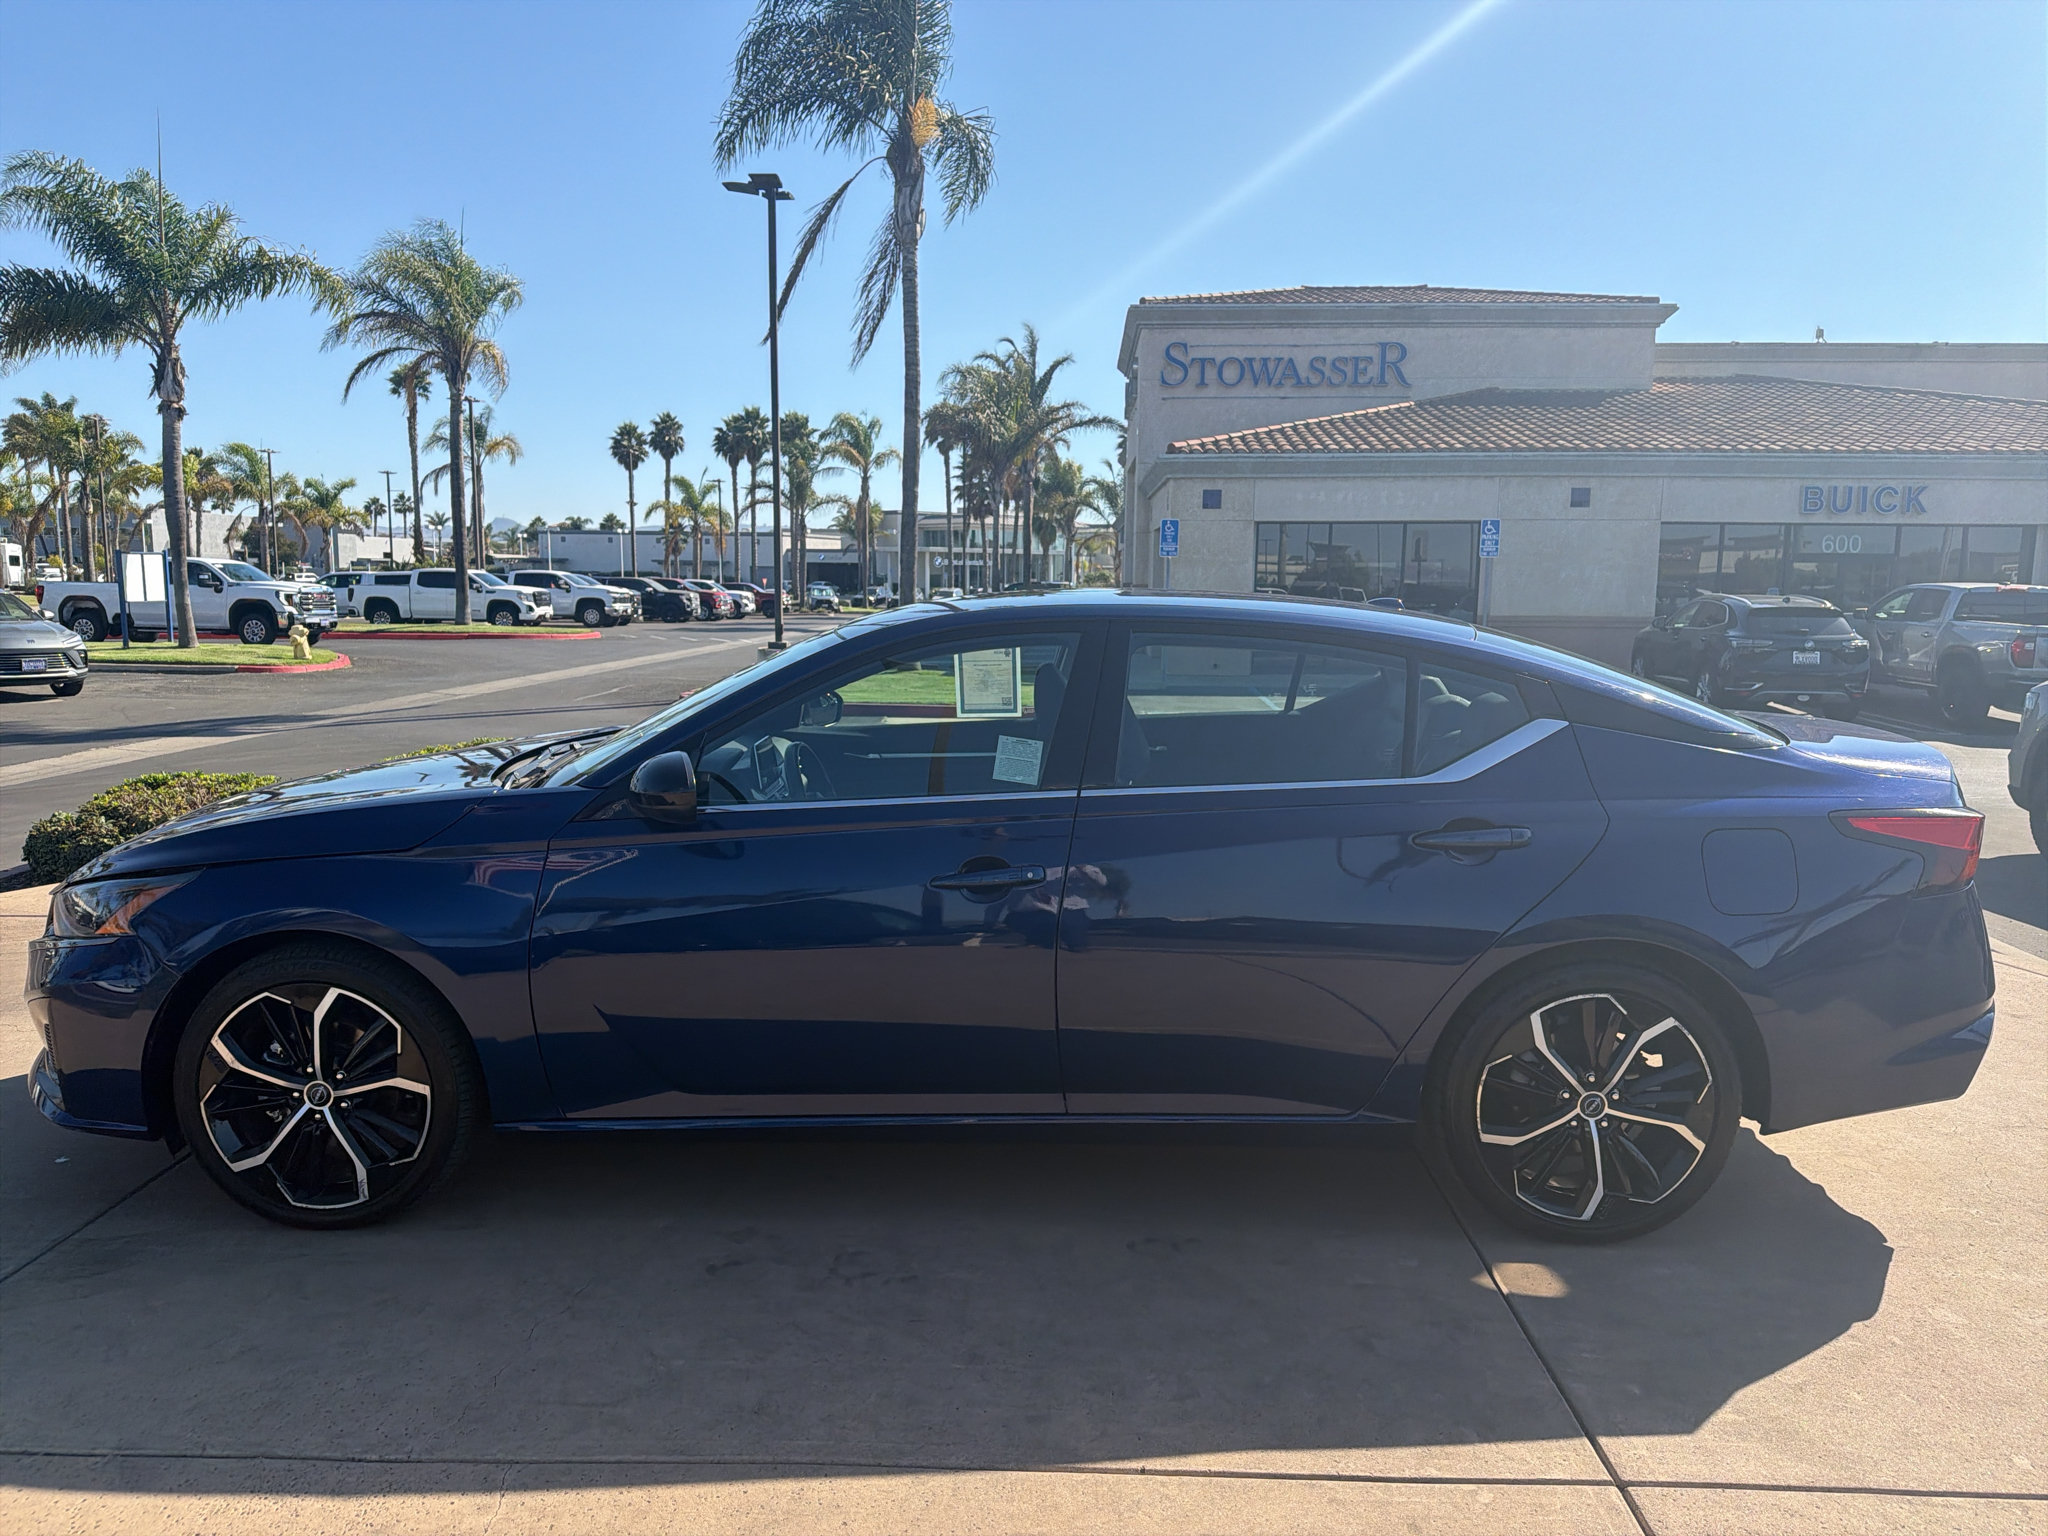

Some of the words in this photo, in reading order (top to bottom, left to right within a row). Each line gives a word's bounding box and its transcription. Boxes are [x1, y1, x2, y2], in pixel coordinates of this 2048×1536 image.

[1160, 341, 1413, 388] STOWASSER
[1801, 484, 1929, 514] BUICK
[1821, 534, 1862, 554] 600
